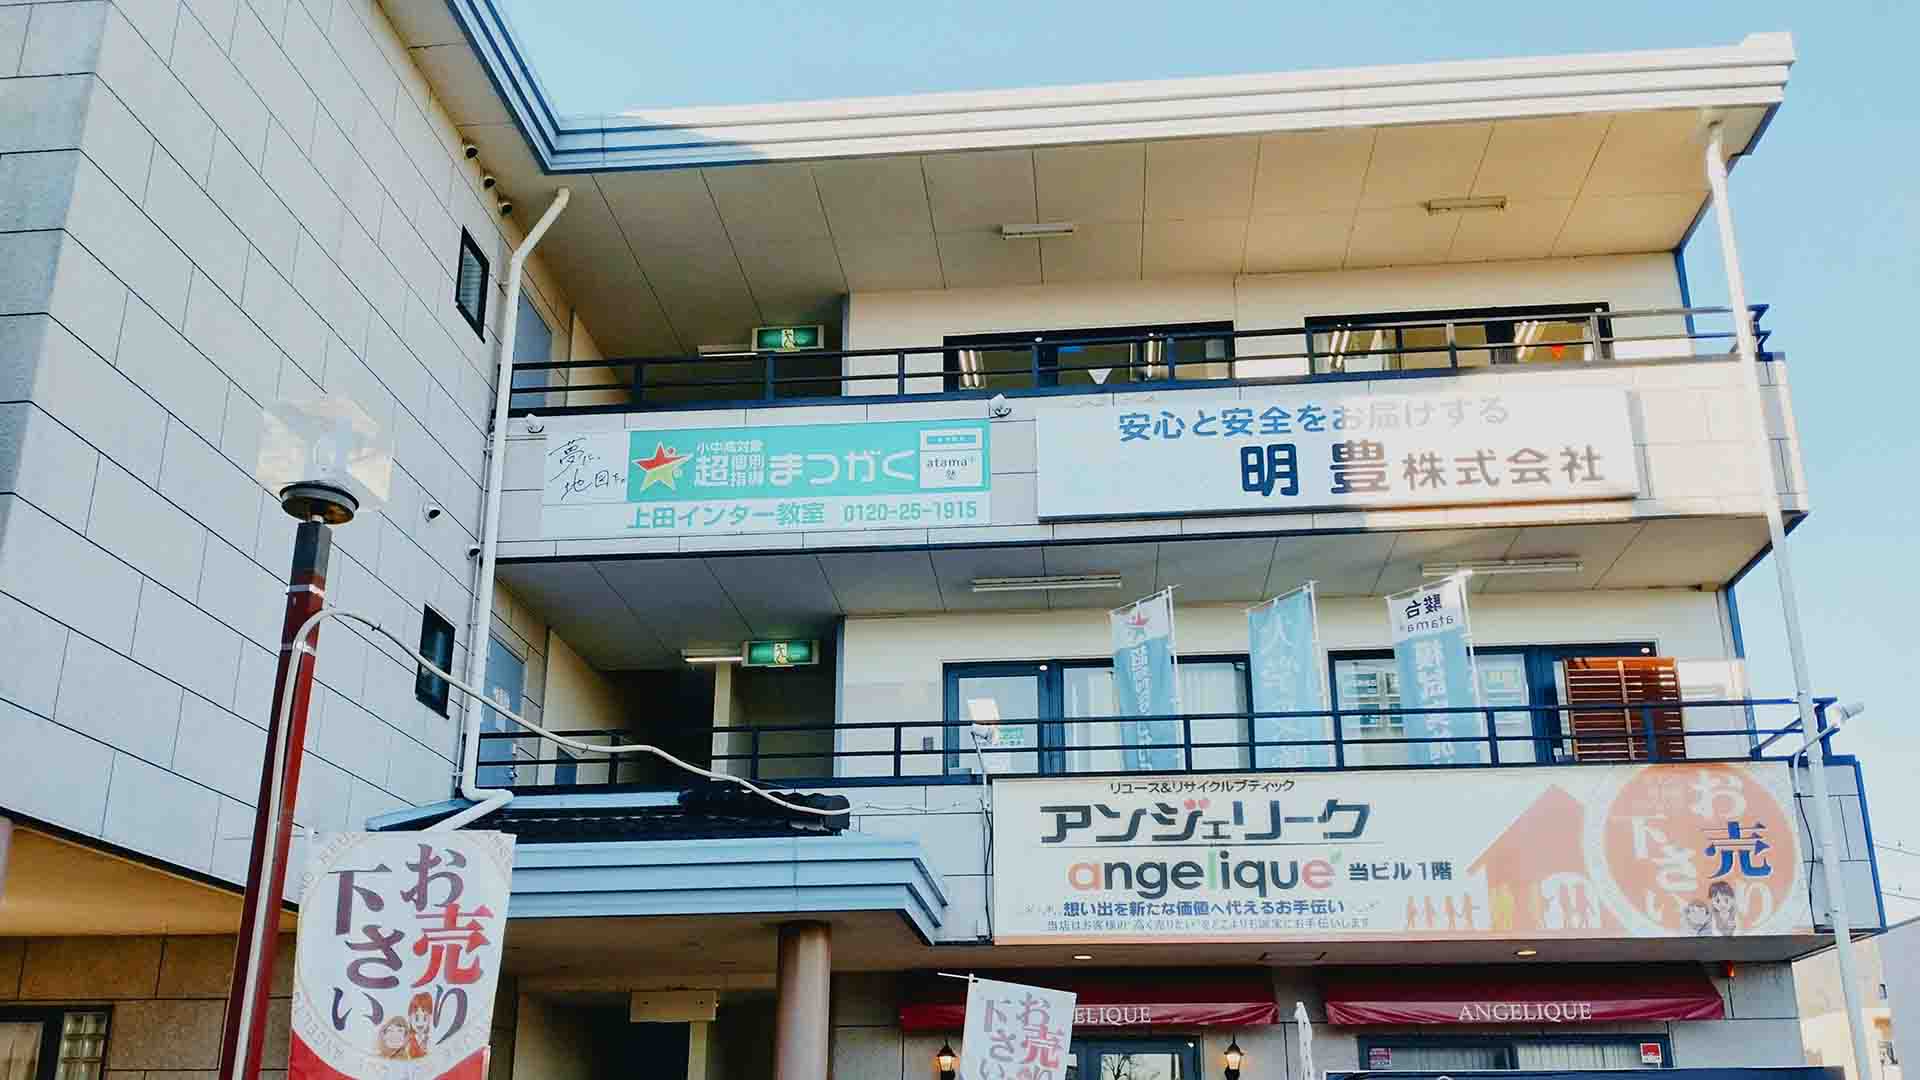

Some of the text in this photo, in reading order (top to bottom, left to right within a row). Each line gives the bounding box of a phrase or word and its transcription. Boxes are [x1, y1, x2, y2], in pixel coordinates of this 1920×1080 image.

[1118, 397, 1509, 442] 安心と安全をお届けする
[694, 455, 728, 486] 超
[768, 449, 915, 487] まつがく
[1239, 441, 1607, 498] 明豊株式会社
[627, 503, 826, 529] 上田インター教室
[843, 501, 978, 523] 0120-25-1915
[1110, 779, 1295, 795] リユース&リサイクルブティック
[1040, 798, 1372, 844] アンジェリーク
[1068, 850, 1338, 898] angelique
[1348, 861, 1453, 882] 当ビル1階
[1063, 899, 1345, 917] 想い出を新たな価値へ代えるお手伝い
[327, 863, 406, 1031] 下さい
[400, 843, 494, 1046] お売り
[1073, 1006, 1152, 1024] ELIQUE
[1457, 1002, 1593, 1021] ANGELIQUE
